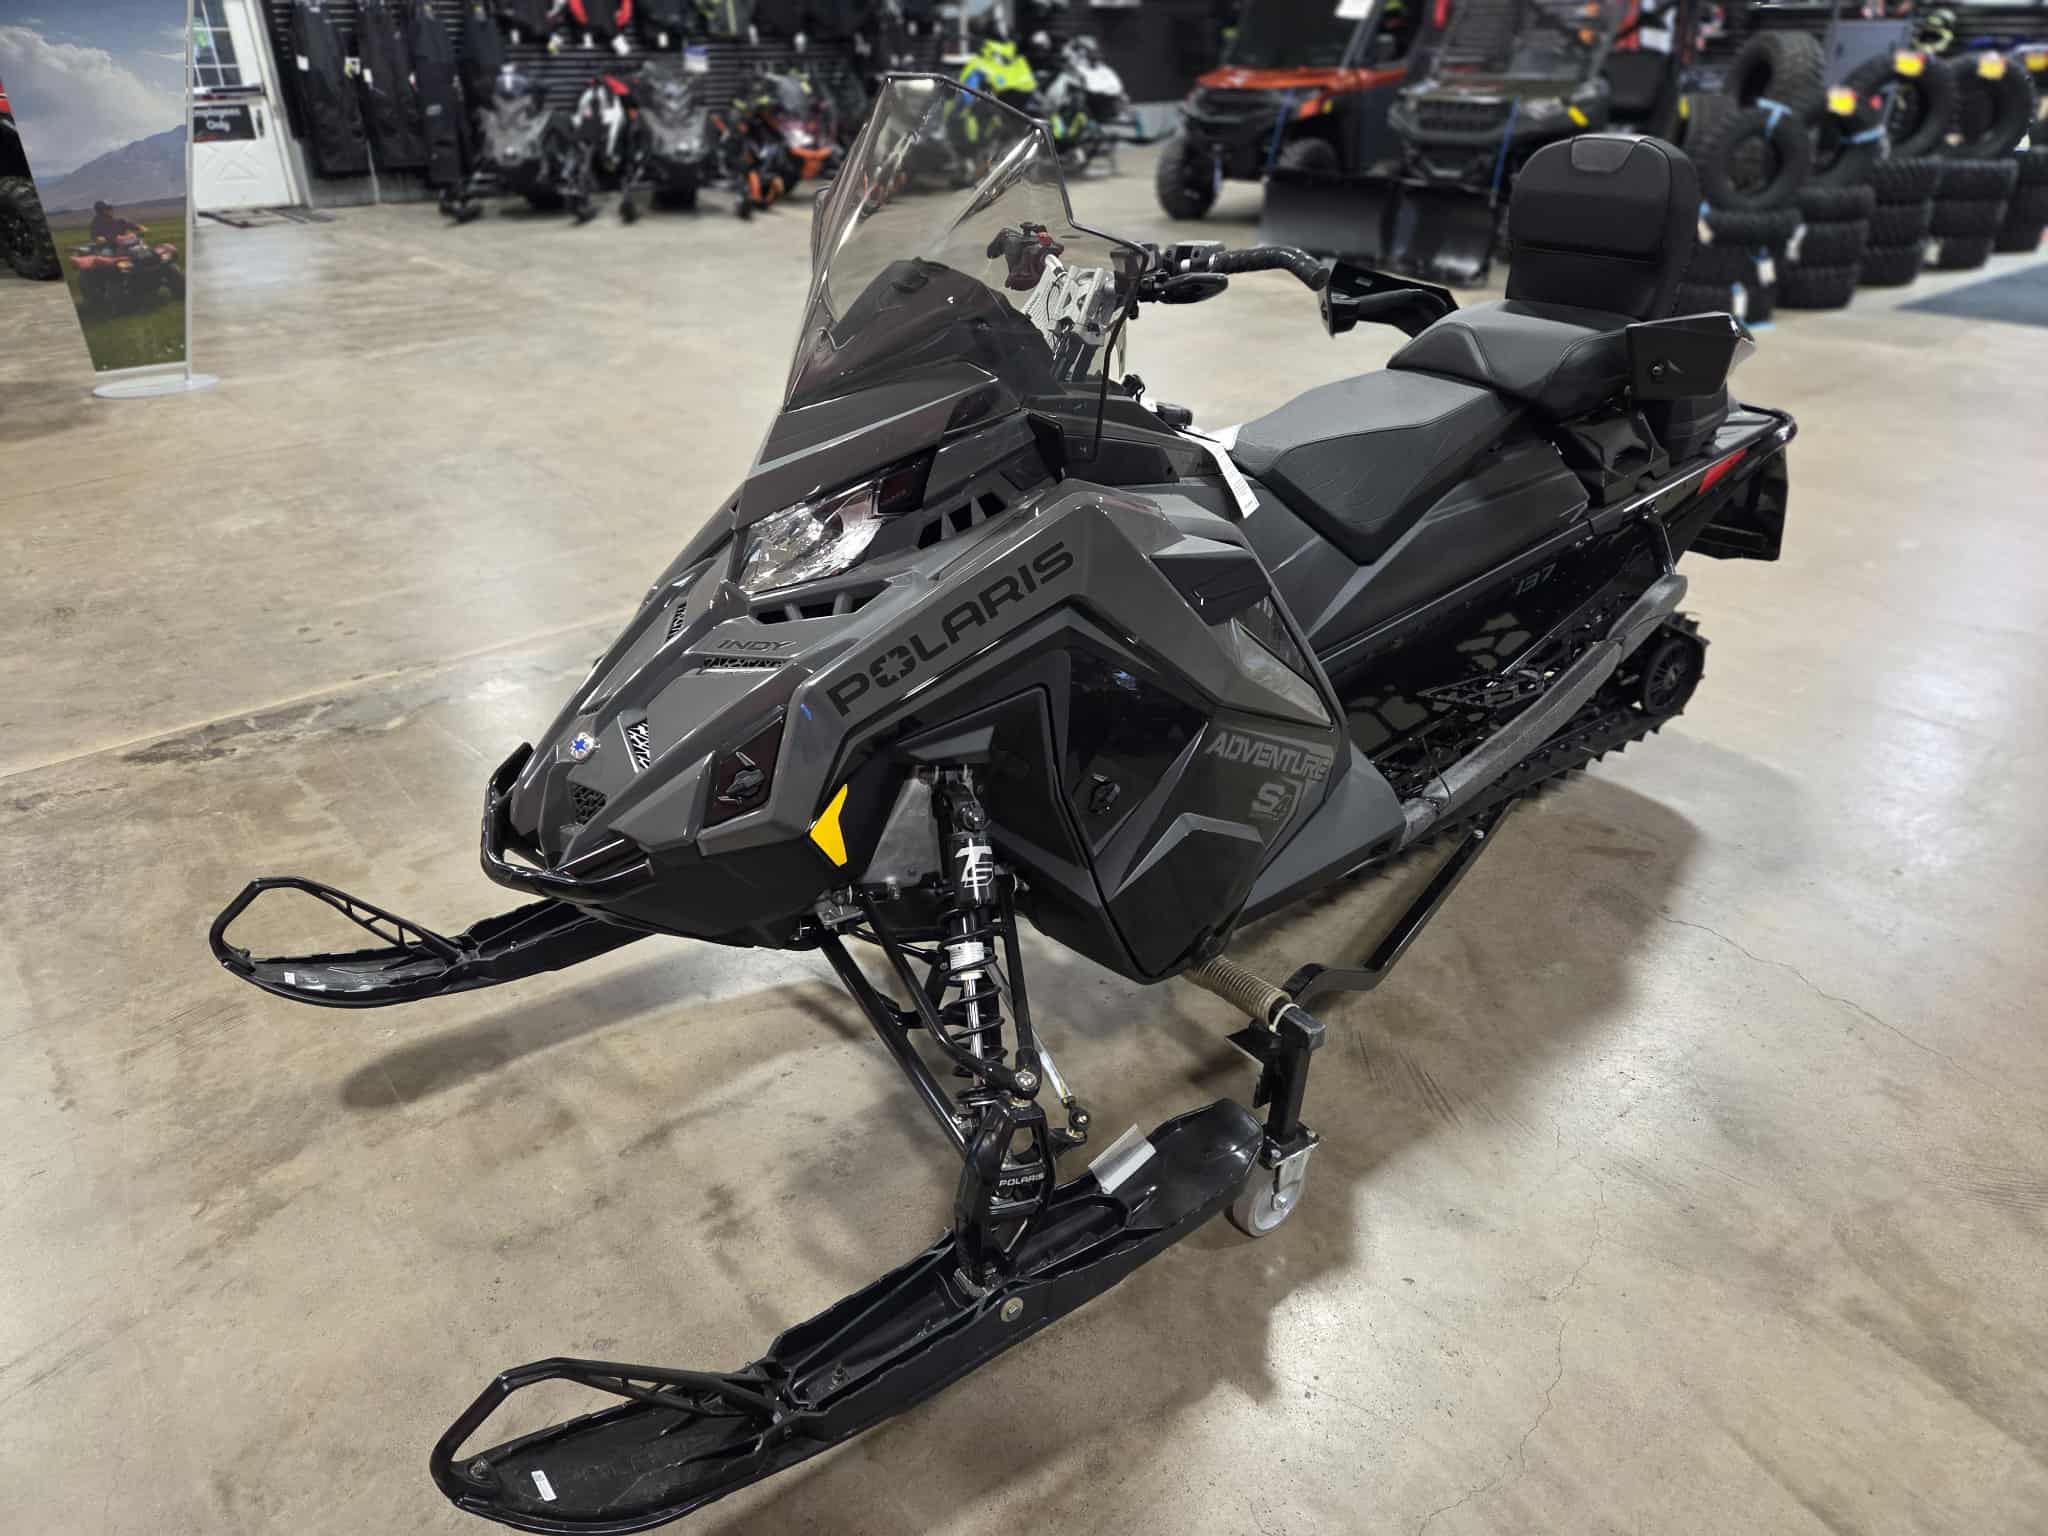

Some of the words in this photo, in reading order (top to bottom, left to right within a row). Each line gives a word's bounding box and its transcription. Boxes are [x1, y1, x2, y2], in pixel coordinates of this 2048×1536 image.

[1515, 563, 1557, 597] 137
[717, 639, 797, 652] INDY
[826, 541, 1075, 717] POLARIS
[1205, 730, 1330, 782] ADVENTURE
[999, 1172, 1045, 1186] POLARIS
